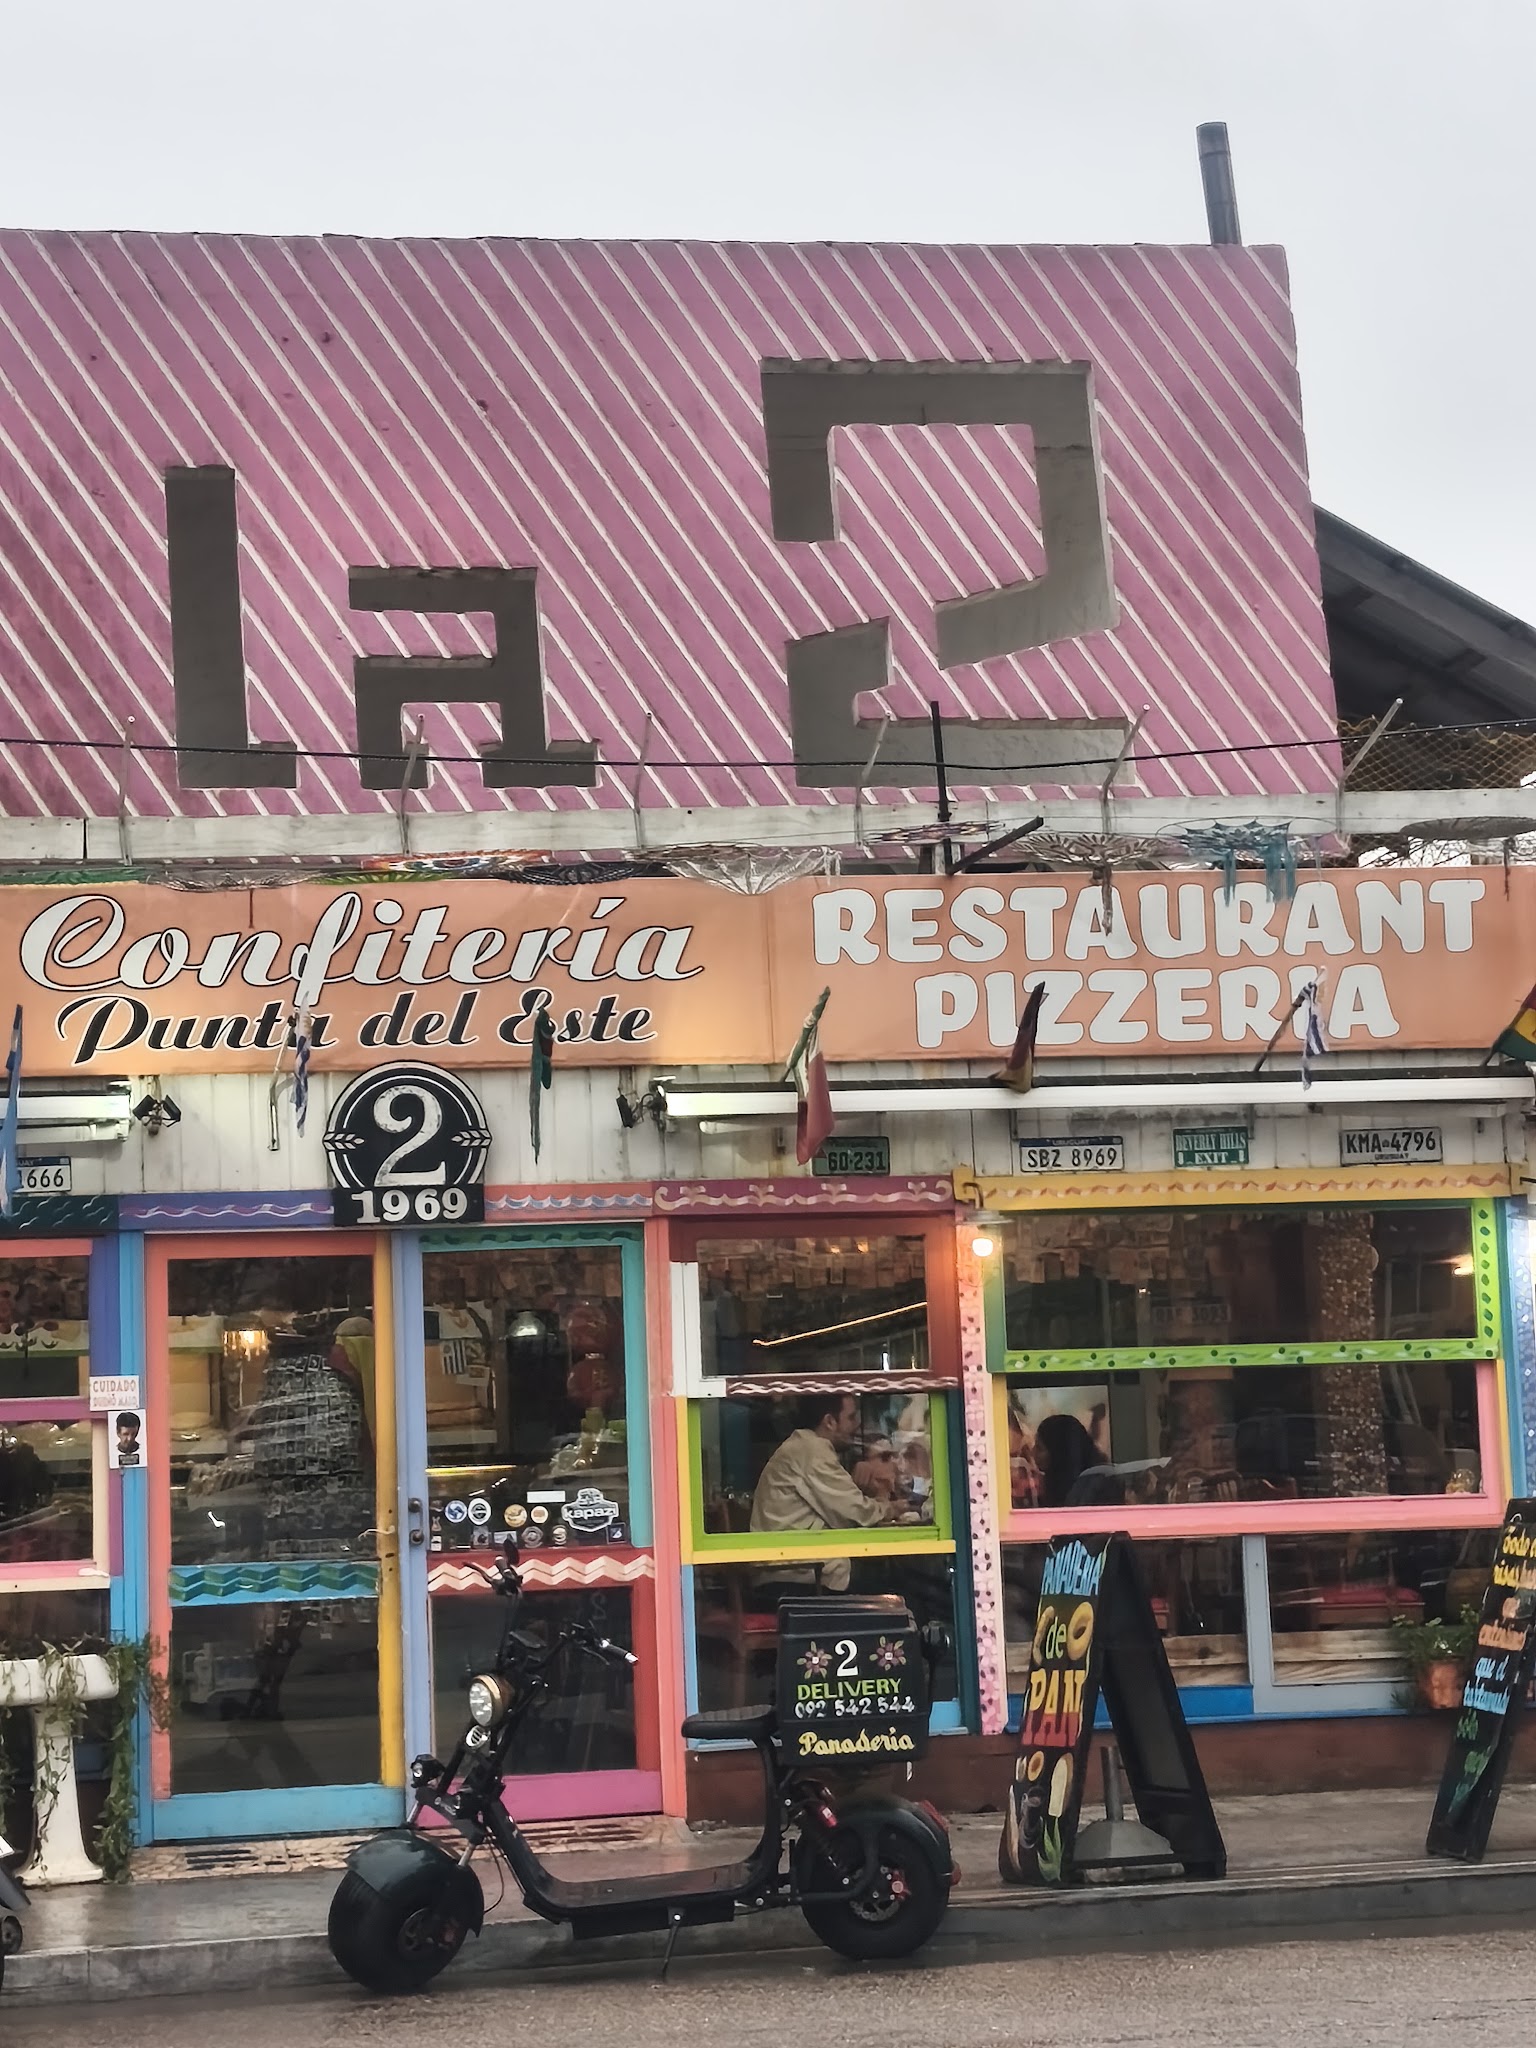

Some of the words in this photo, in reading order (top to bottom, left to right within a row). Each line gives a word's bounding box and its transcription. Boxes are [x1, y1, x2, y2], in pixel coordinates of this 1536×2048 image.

[760, 358, 1136, 788] 2
[813, 878, 1487, 965] RESTAURANT
[20, 891, 704, 1008] Confitería
[358, 989, 480, 1047] del
[498, 987, 658, 1047] Este
[915, 964, 1400, 1049] PIZZERIA
[373, 1085, 446, 1187] 2
[1175, 1133, 1217, 1151] BEVERLY
[1219, 1132, 1247, 1150] HILLS
[1346, 1133, 1382, 1154] KMA
[1390, 1131, 1436, 1152] 4796
[1027, 1149, 1062, 1168] SBZ
[1071, 1147, 1117, 1167] 8969
[1194, 1151, 1228, 1165] EXIT
[351, 1187, 468, 1224] 1969
[92, 1379, 137, 1393] CUIDADO
[1045, 1616, 1067, 1660] de
[834, 1639, 859, 1677] 2
[795, 1700, 826, 1719] 092
[834, 1698, 873, 1716] 542
[877, 1695, 915, 1713] 544
[797, 1678, 902, 1700] DELIVERY
[1020, 1667, 1086, 1748] PAN
